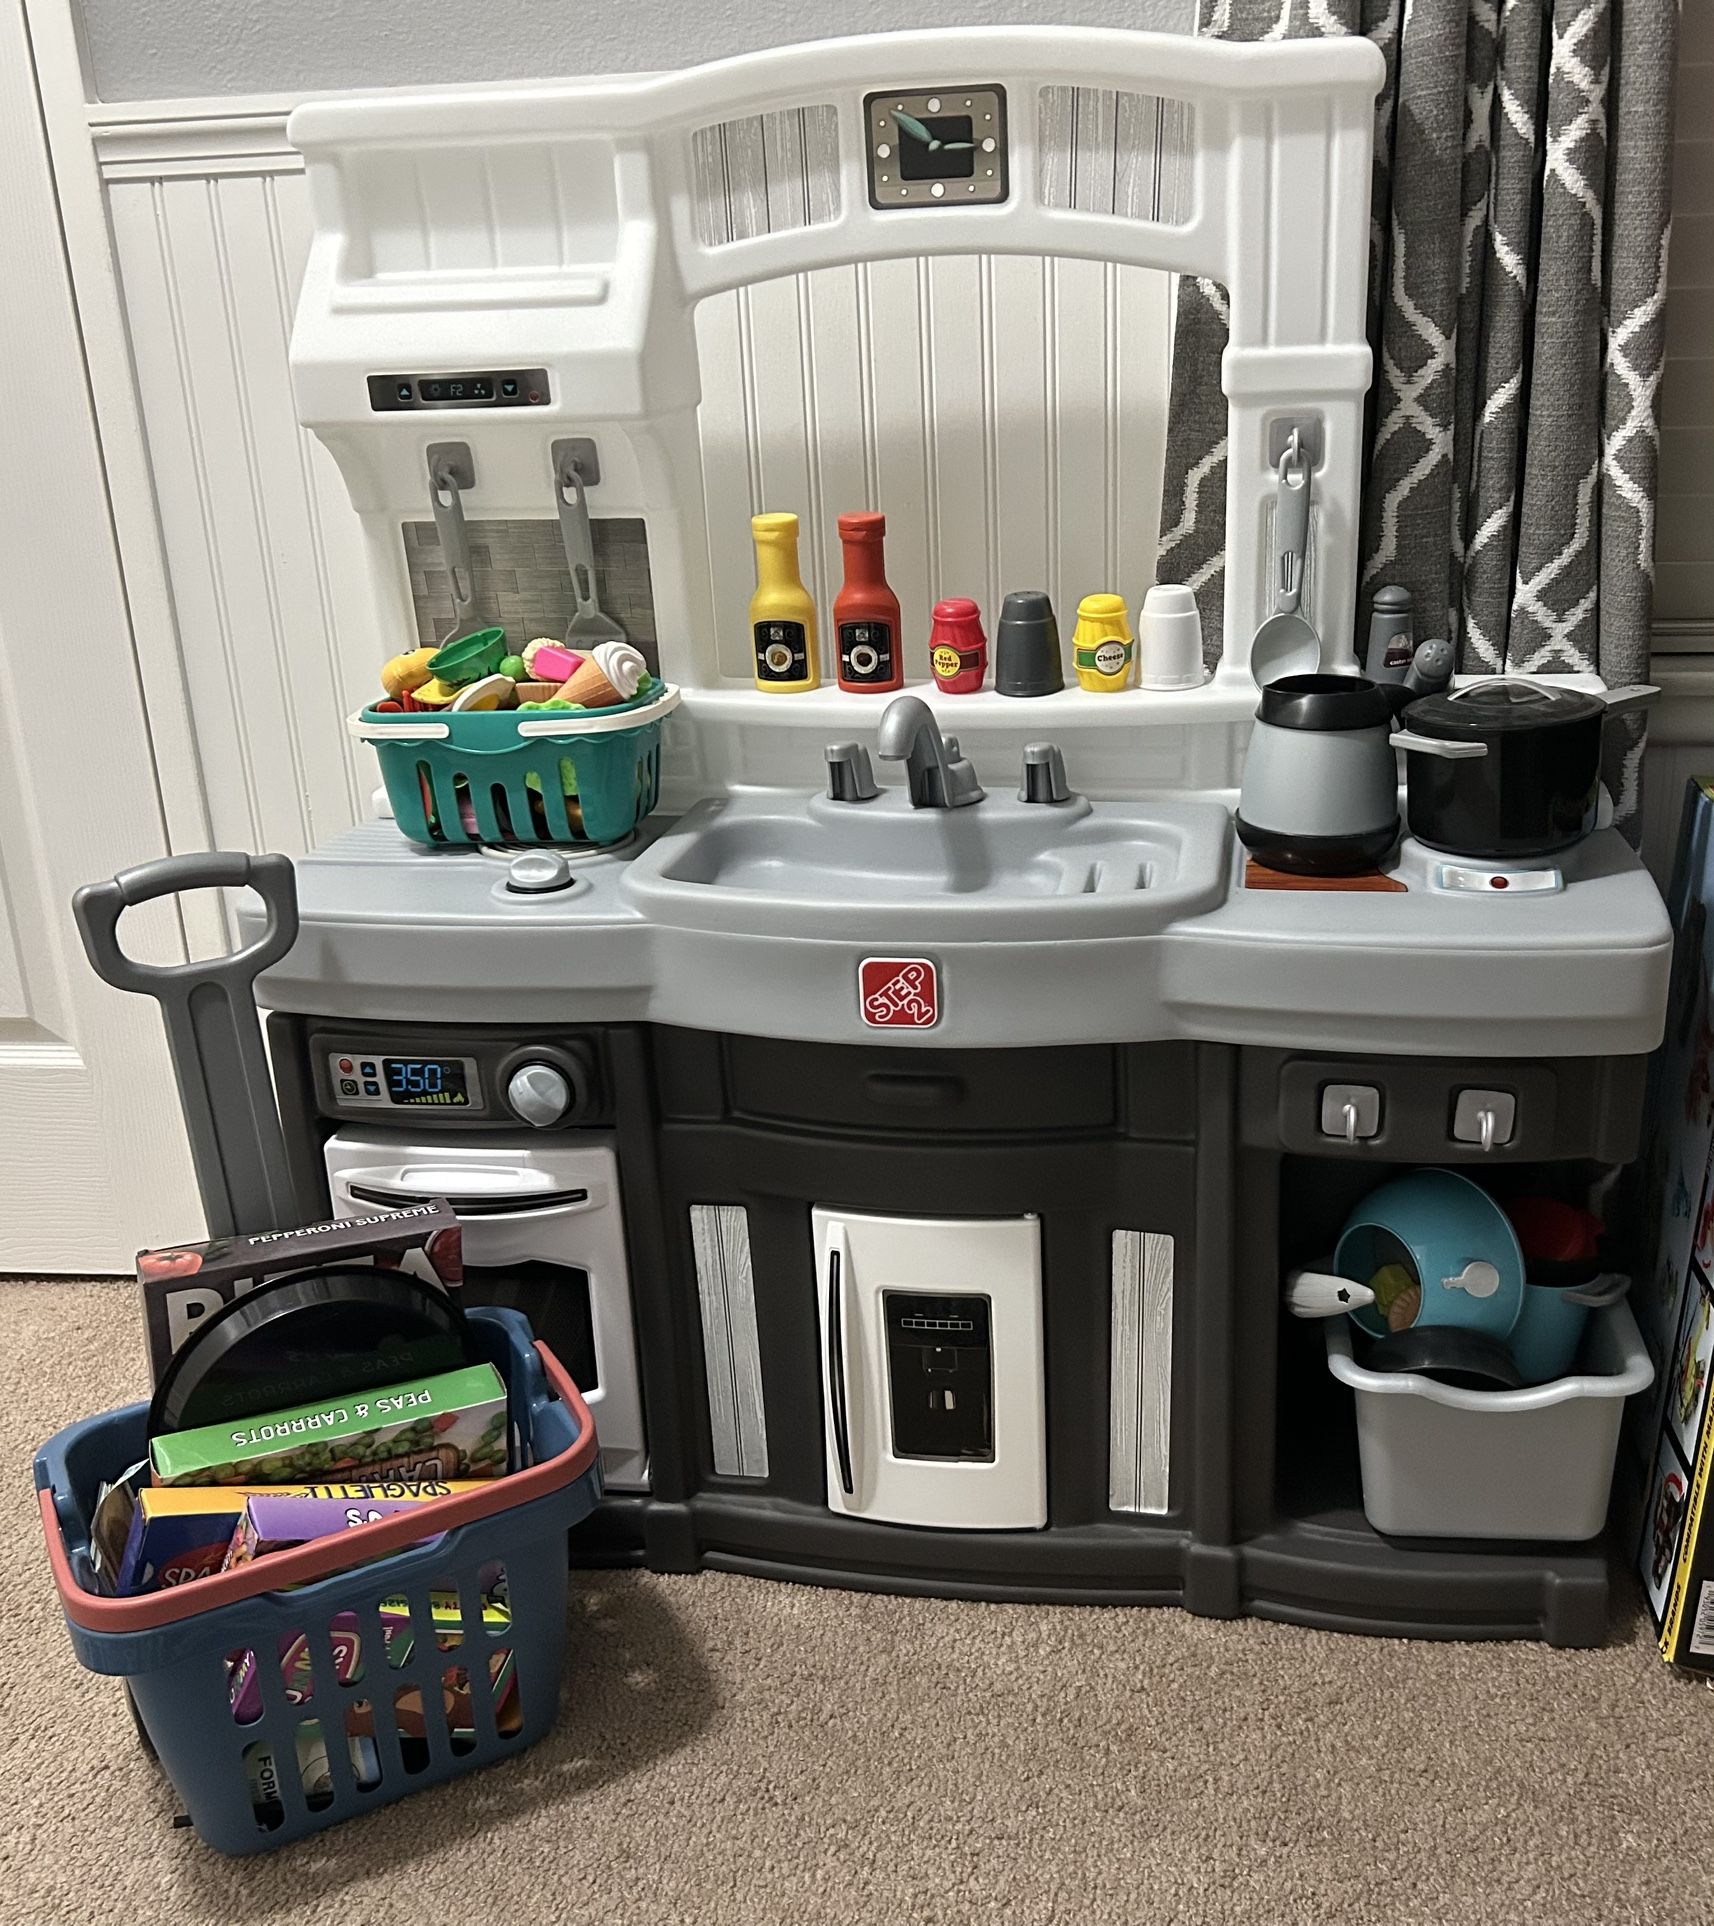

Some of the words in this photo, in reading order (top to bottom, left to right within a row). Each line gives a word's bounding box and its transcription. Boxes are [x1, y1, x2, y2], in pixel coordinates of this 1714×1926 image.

[451, 384, 463, 396] F2
[935, 661, 958, 669] Pepper
[939, 654, 952, 662] Red
[1097, 653, 1124, 663] Cheese
[866, 964, 924, 1022] STEP
[904, 996, 934, 1024] 2
[248, 1221, 352, 1246] PEPPERONI
[355, 1204, 440, 1227] SUPREME
[355, 1403, 370, 1418] &
[375, 1388, 433, 1413] PEAS
[231, 1407, 349, 1447] CARRROTS
[304, 1479, 452, 1500] SPAGHETTI
[1682, 1482, 1701, 1564] COMPATIBLE
[1698, 1442, 1709, 1480] WITH
[1667, 1582, 1682, 1637] BRANDS
